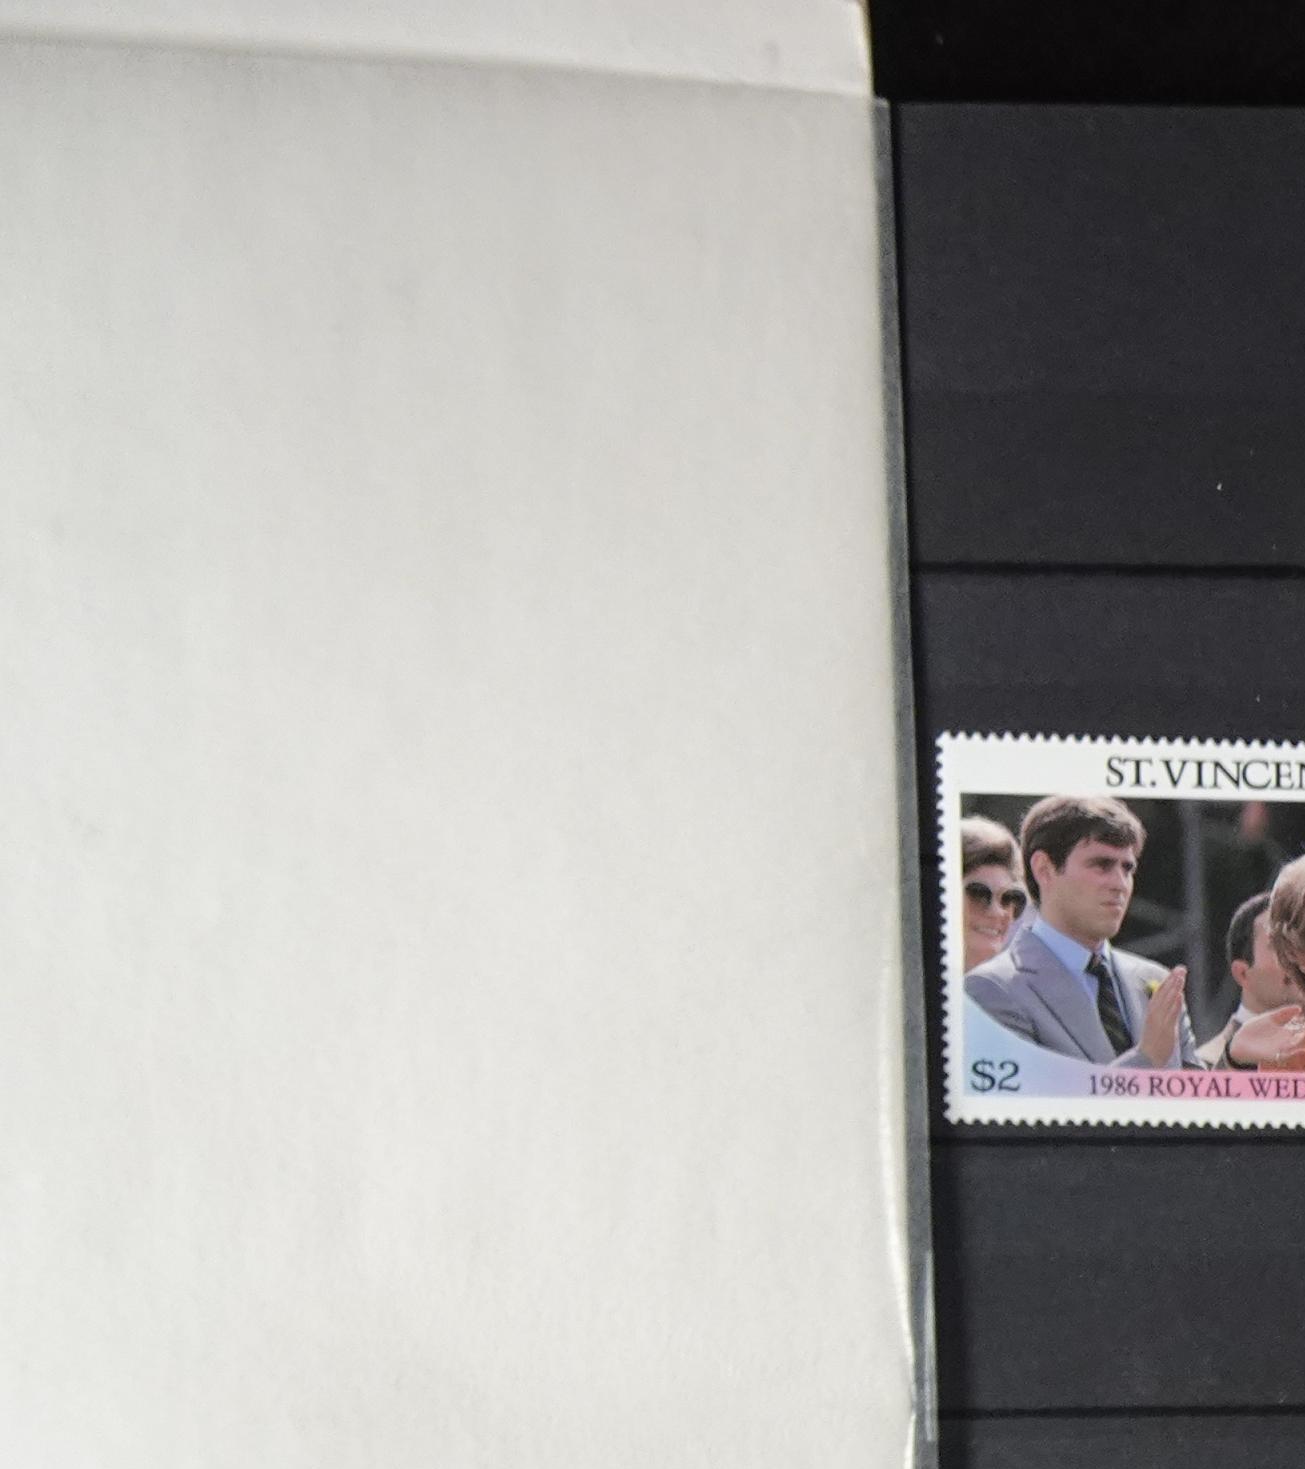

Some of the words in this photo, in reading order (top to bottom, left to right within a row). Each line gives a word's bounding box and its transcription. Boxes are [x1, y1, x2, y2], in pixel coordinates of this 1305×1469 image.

[970, 1060, 1021, 1094] $2
[1088, 1074, 1140, 1097] 1986
[1148, 1077, 1241, 1099] ROYAL
